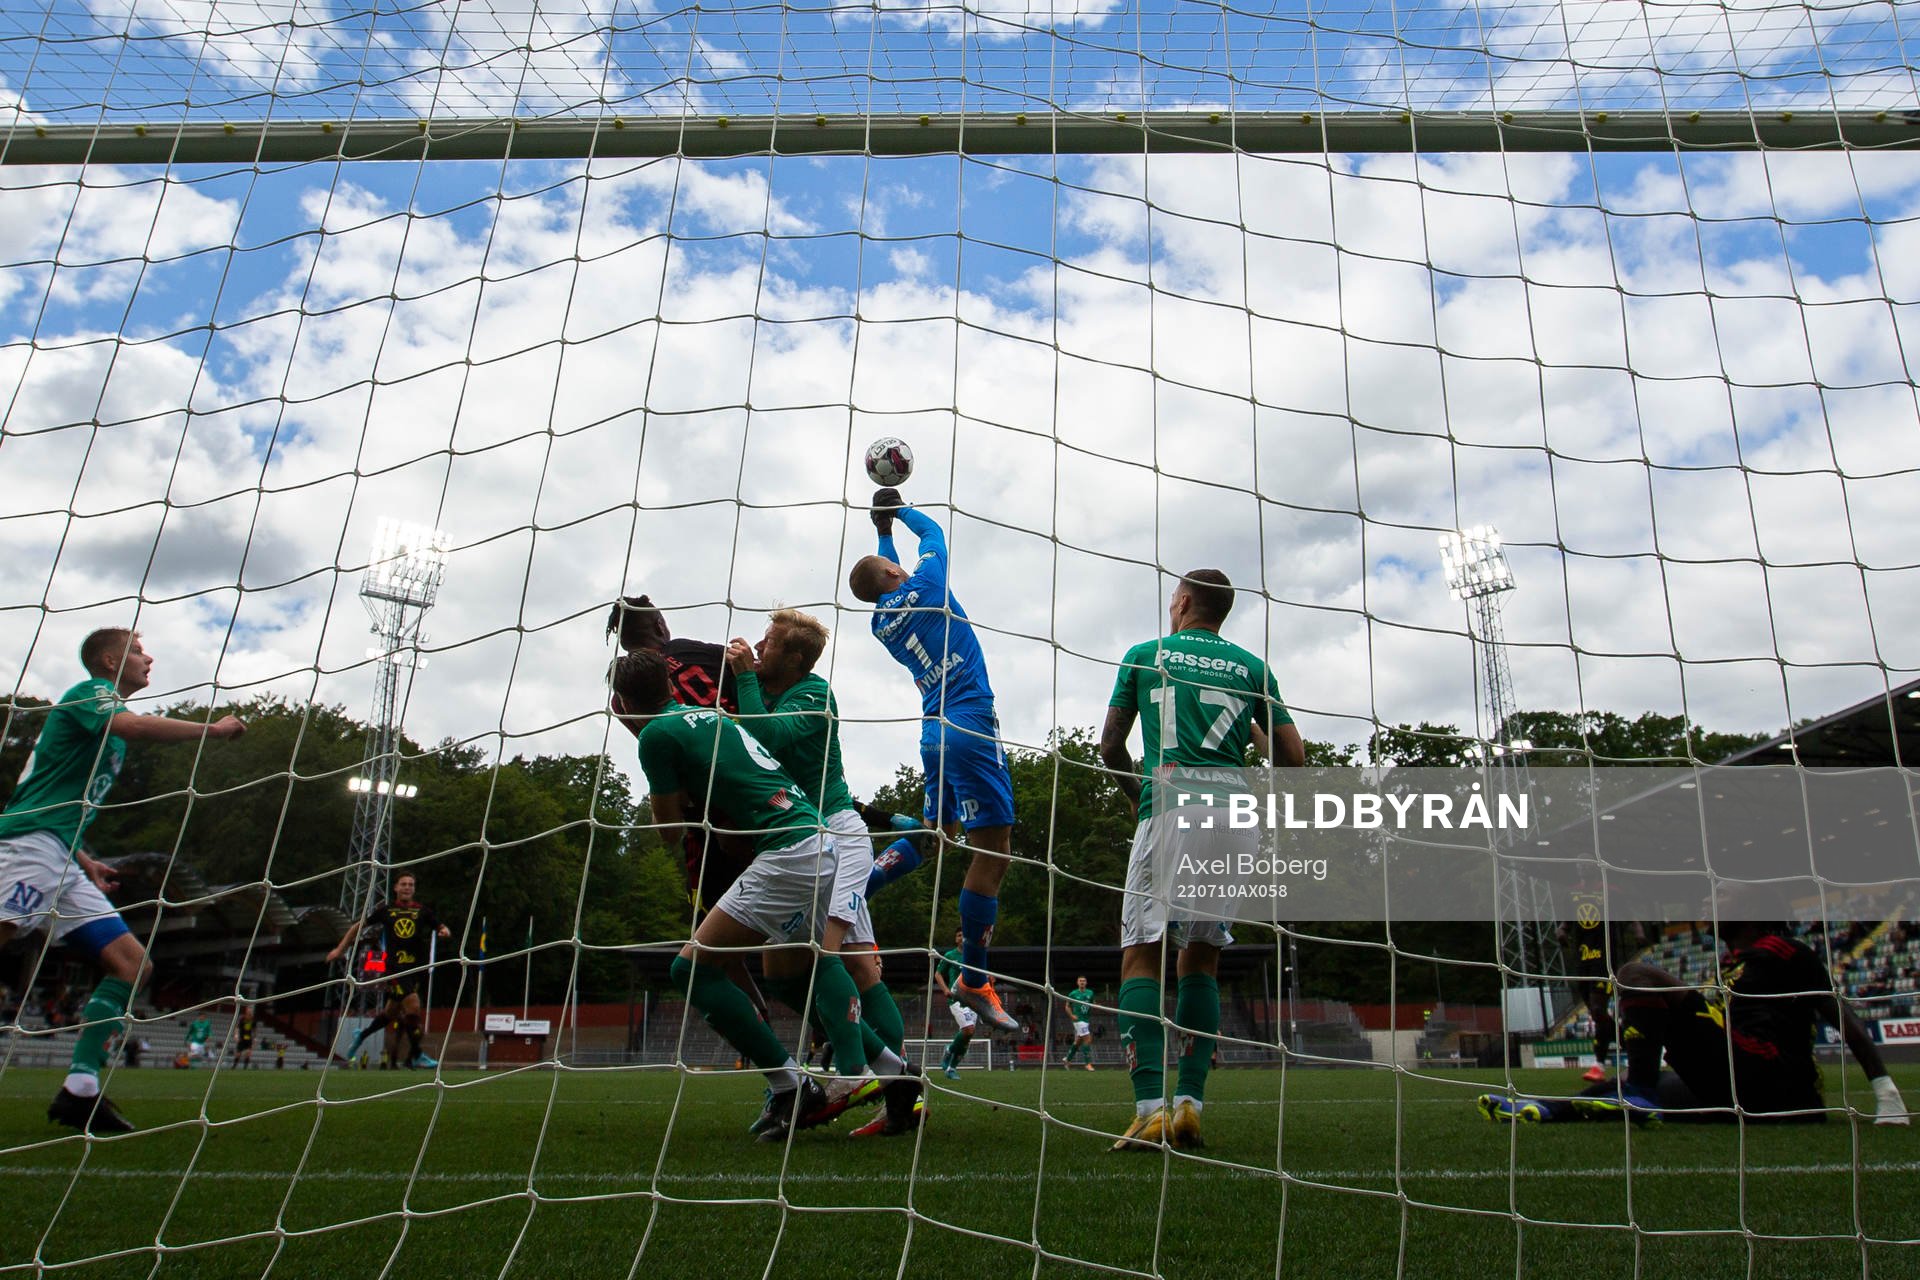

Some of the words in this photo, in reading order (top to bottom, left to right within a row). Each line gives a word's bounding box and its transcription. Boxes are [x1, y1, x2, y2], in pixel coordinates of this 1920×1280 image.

[905, 632, 933, 670] 1
[1154, 649, 1249, 678] Passera
[921, 652, 965, 689] YUASA
[1150, 685, 1249, 751] 17
[960, 798, 980, 823] JP
